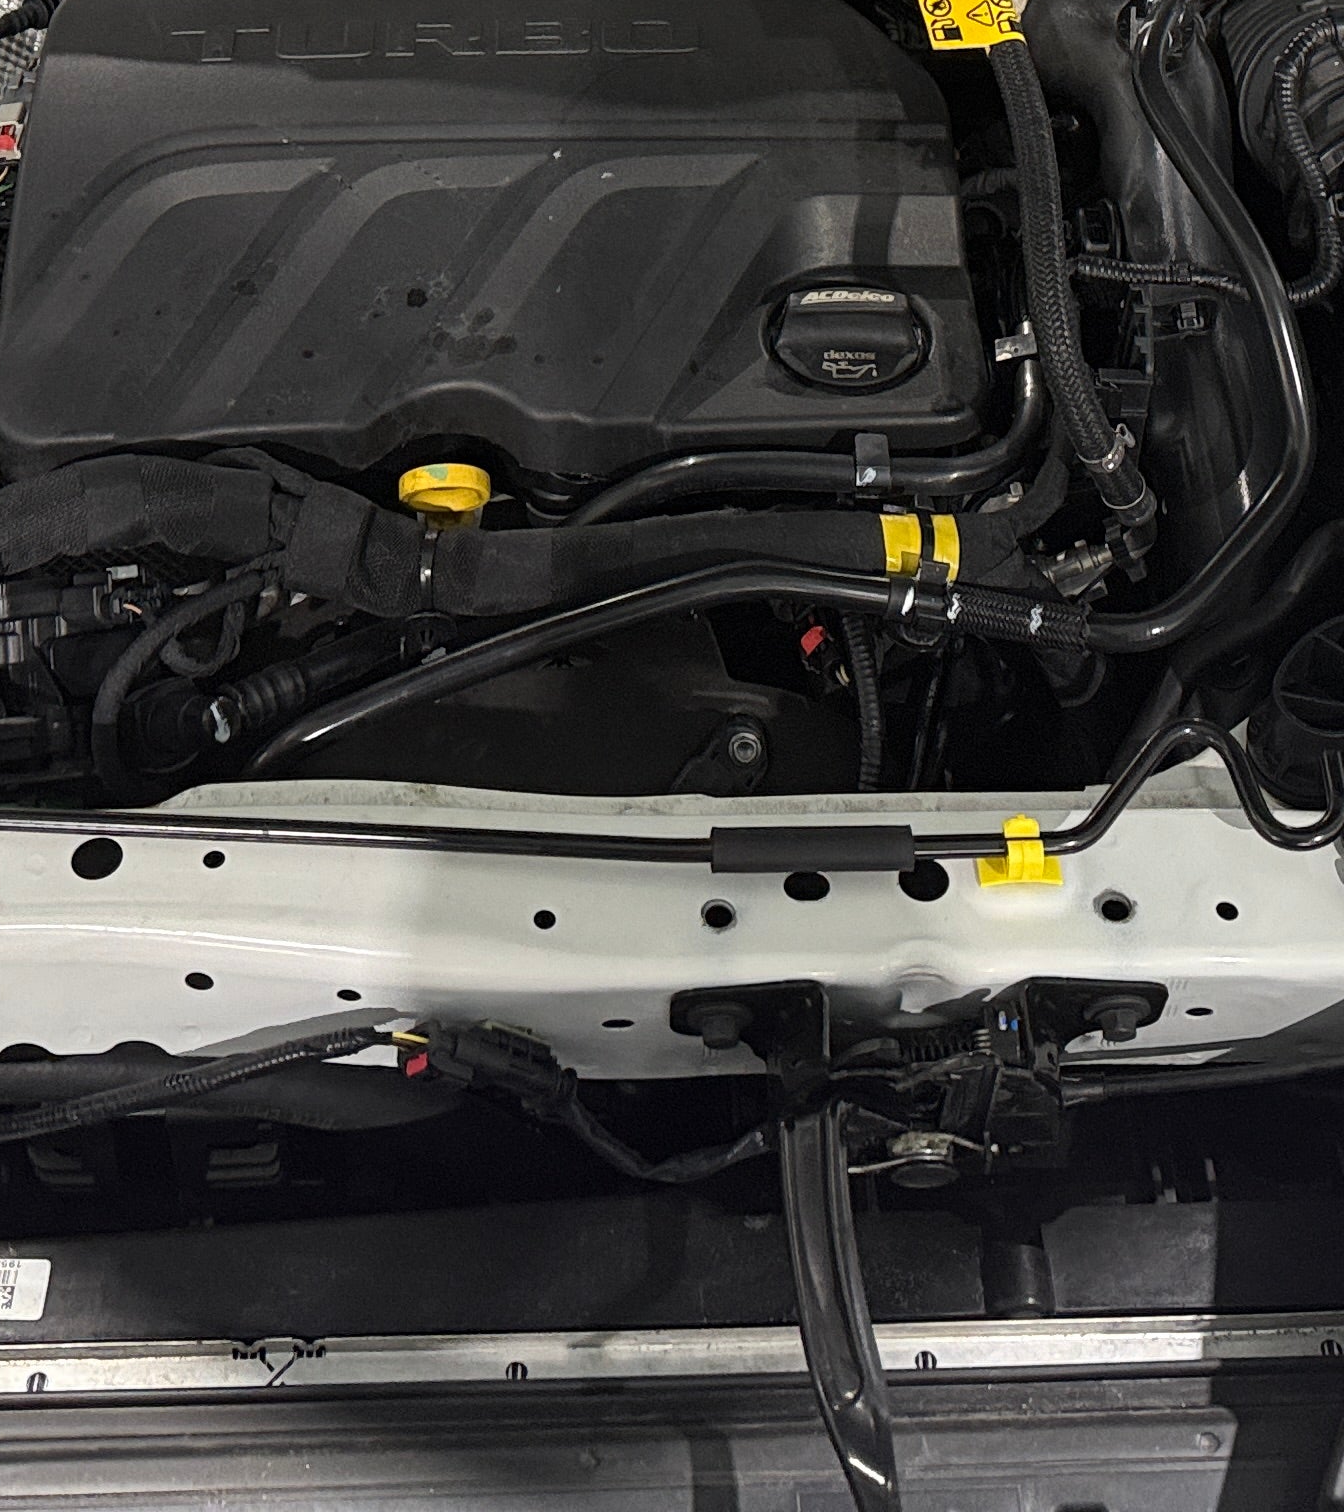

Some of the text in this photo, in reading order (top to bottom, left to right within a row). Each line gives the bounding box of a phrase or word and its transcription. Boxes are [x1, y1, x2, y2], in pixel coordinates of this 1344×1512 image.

[171, 20, 700, 63] TURBO
[800, 290, 895, 305] ACDelco
[823, 349, 876, 360] dexos
